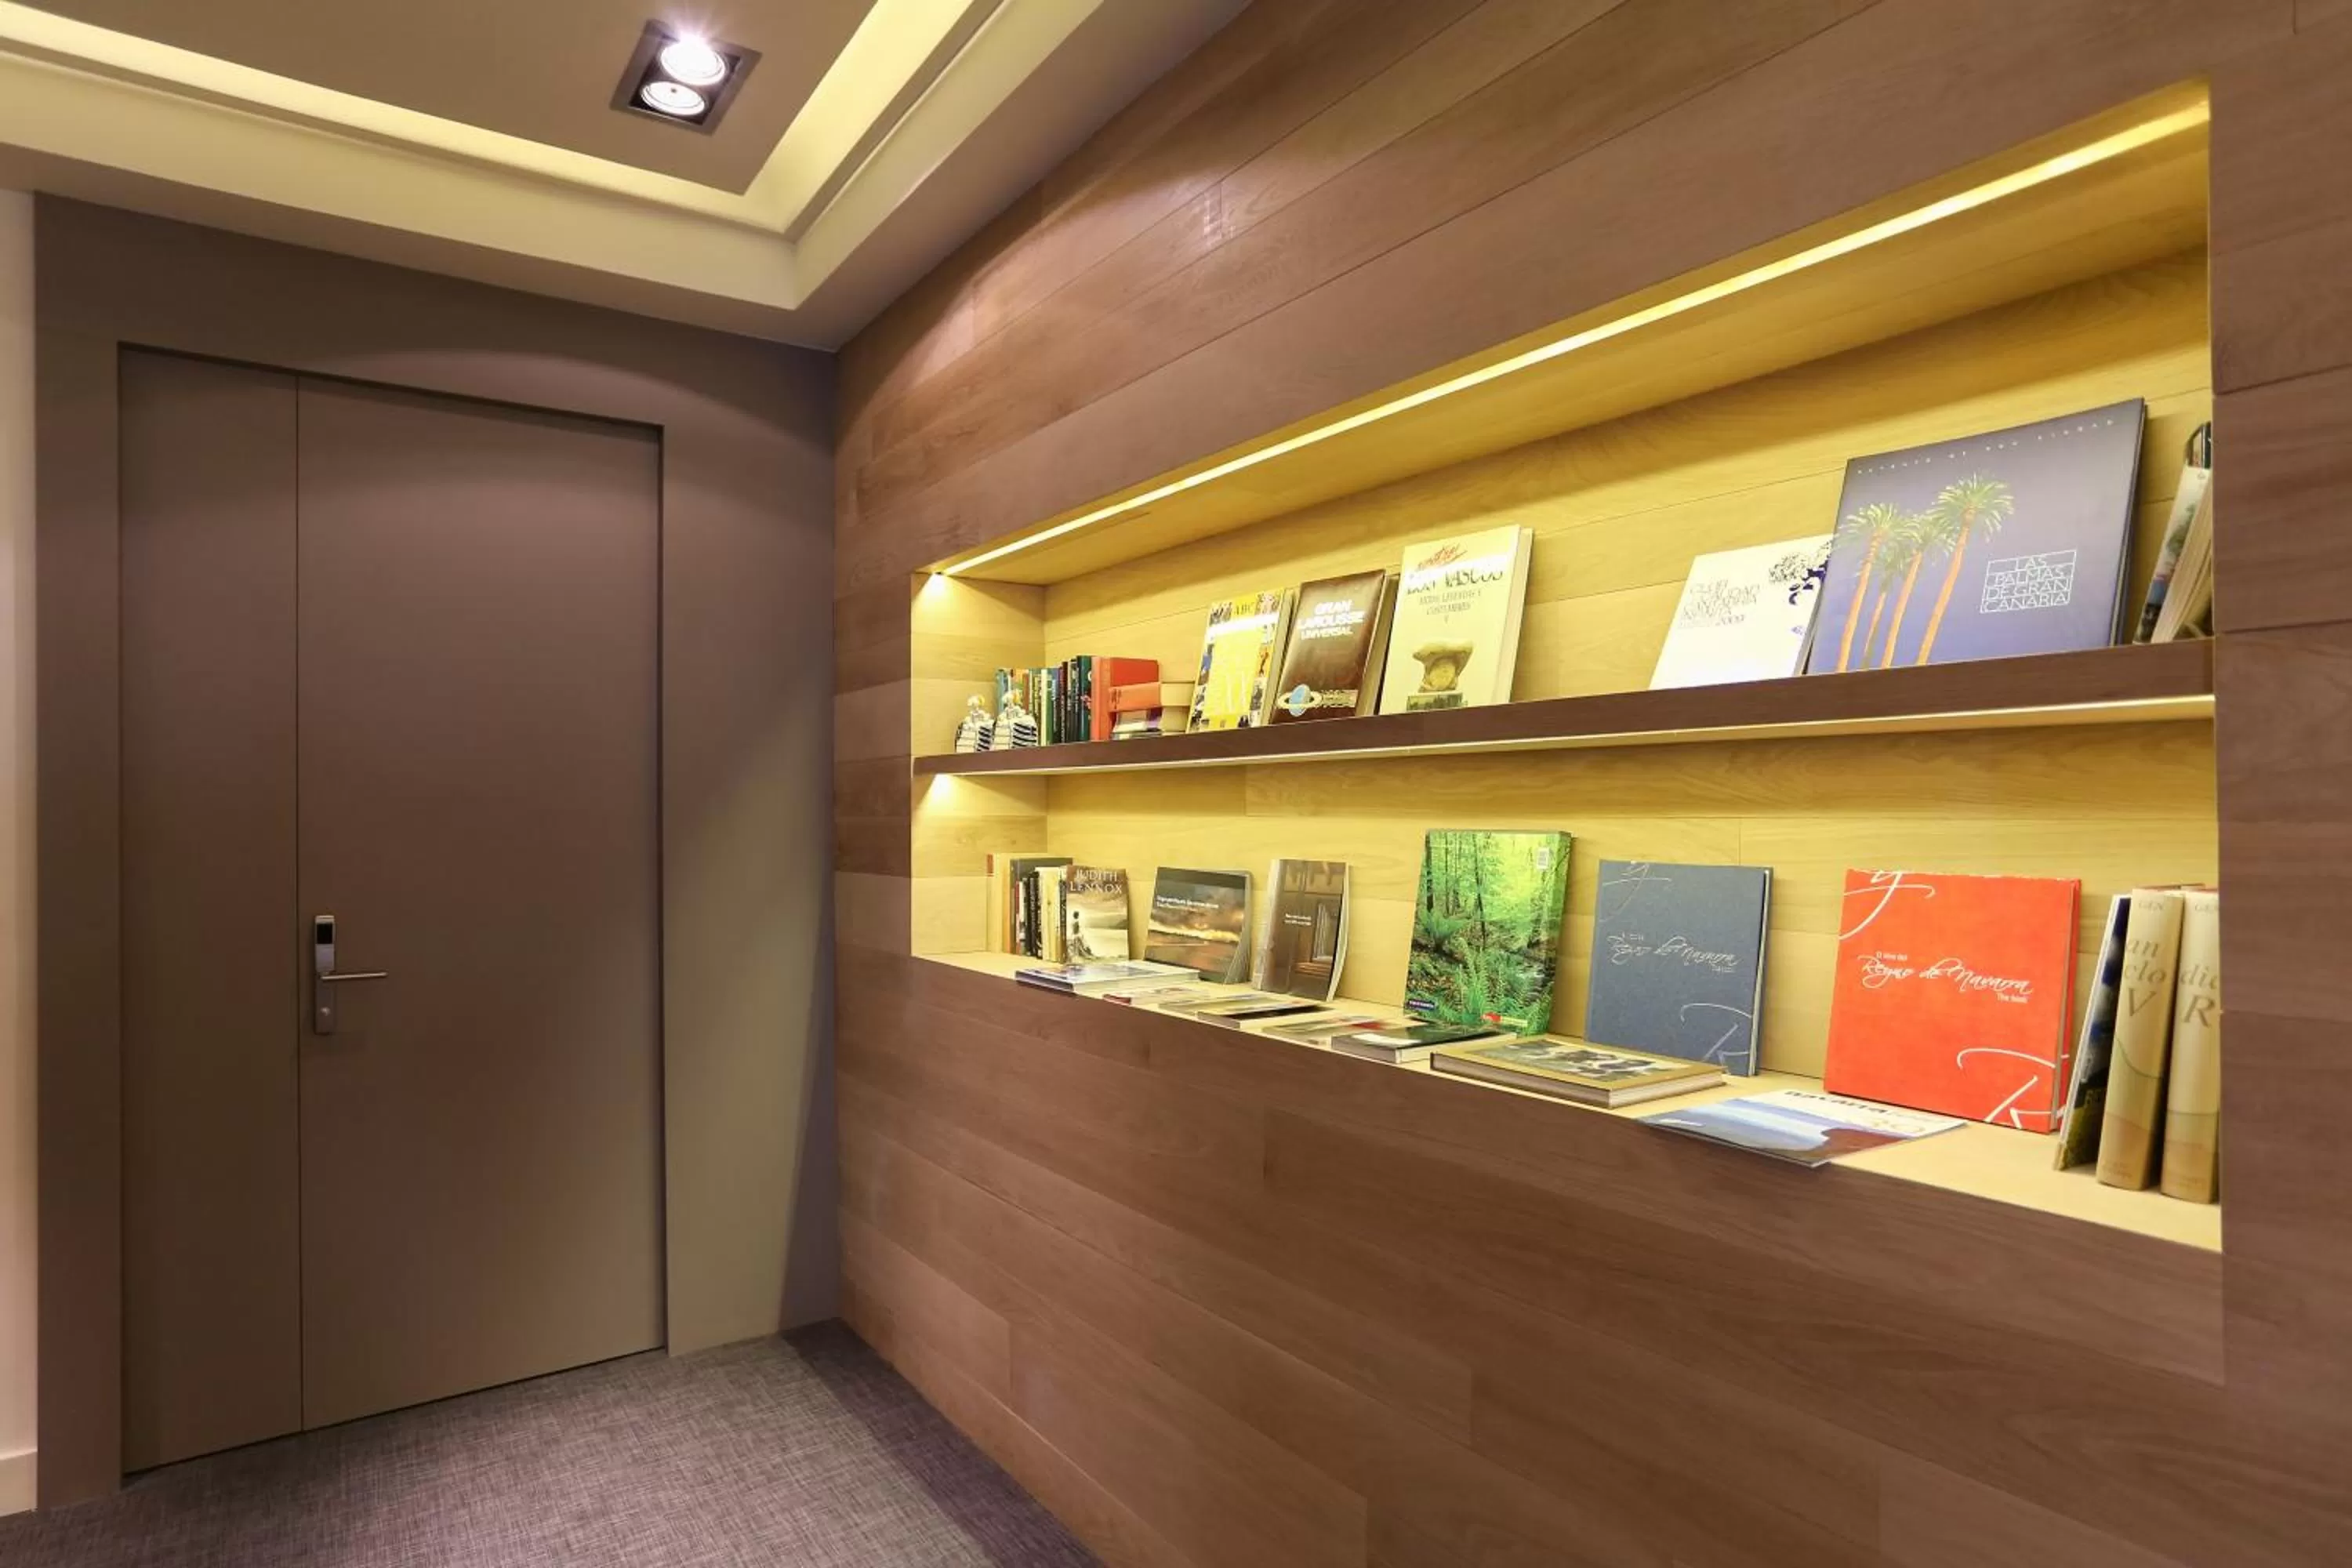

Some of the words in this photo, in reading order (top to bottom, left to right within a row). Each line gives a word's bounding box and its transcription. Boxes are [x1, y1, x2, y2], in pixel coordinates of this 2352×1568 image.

[2016, 556, 2047, 572] LAS
[1994, 566, 2064, 587] PALMAS
[1315, 599, 1353, 615] GRAN
[1984, 592, 2071, 612] CANARIA
[1297, 610, 1366, 630] LAROUSSE
[1301, 626, 1354, 641] UNIVERSAL
[1075, 869, 1118, 882] JUDITH
[1069, 881, 1123, 895] LENNOX
[2128, 987, 2158, 1017] V
[2182, 994, 2216, 1029] R
